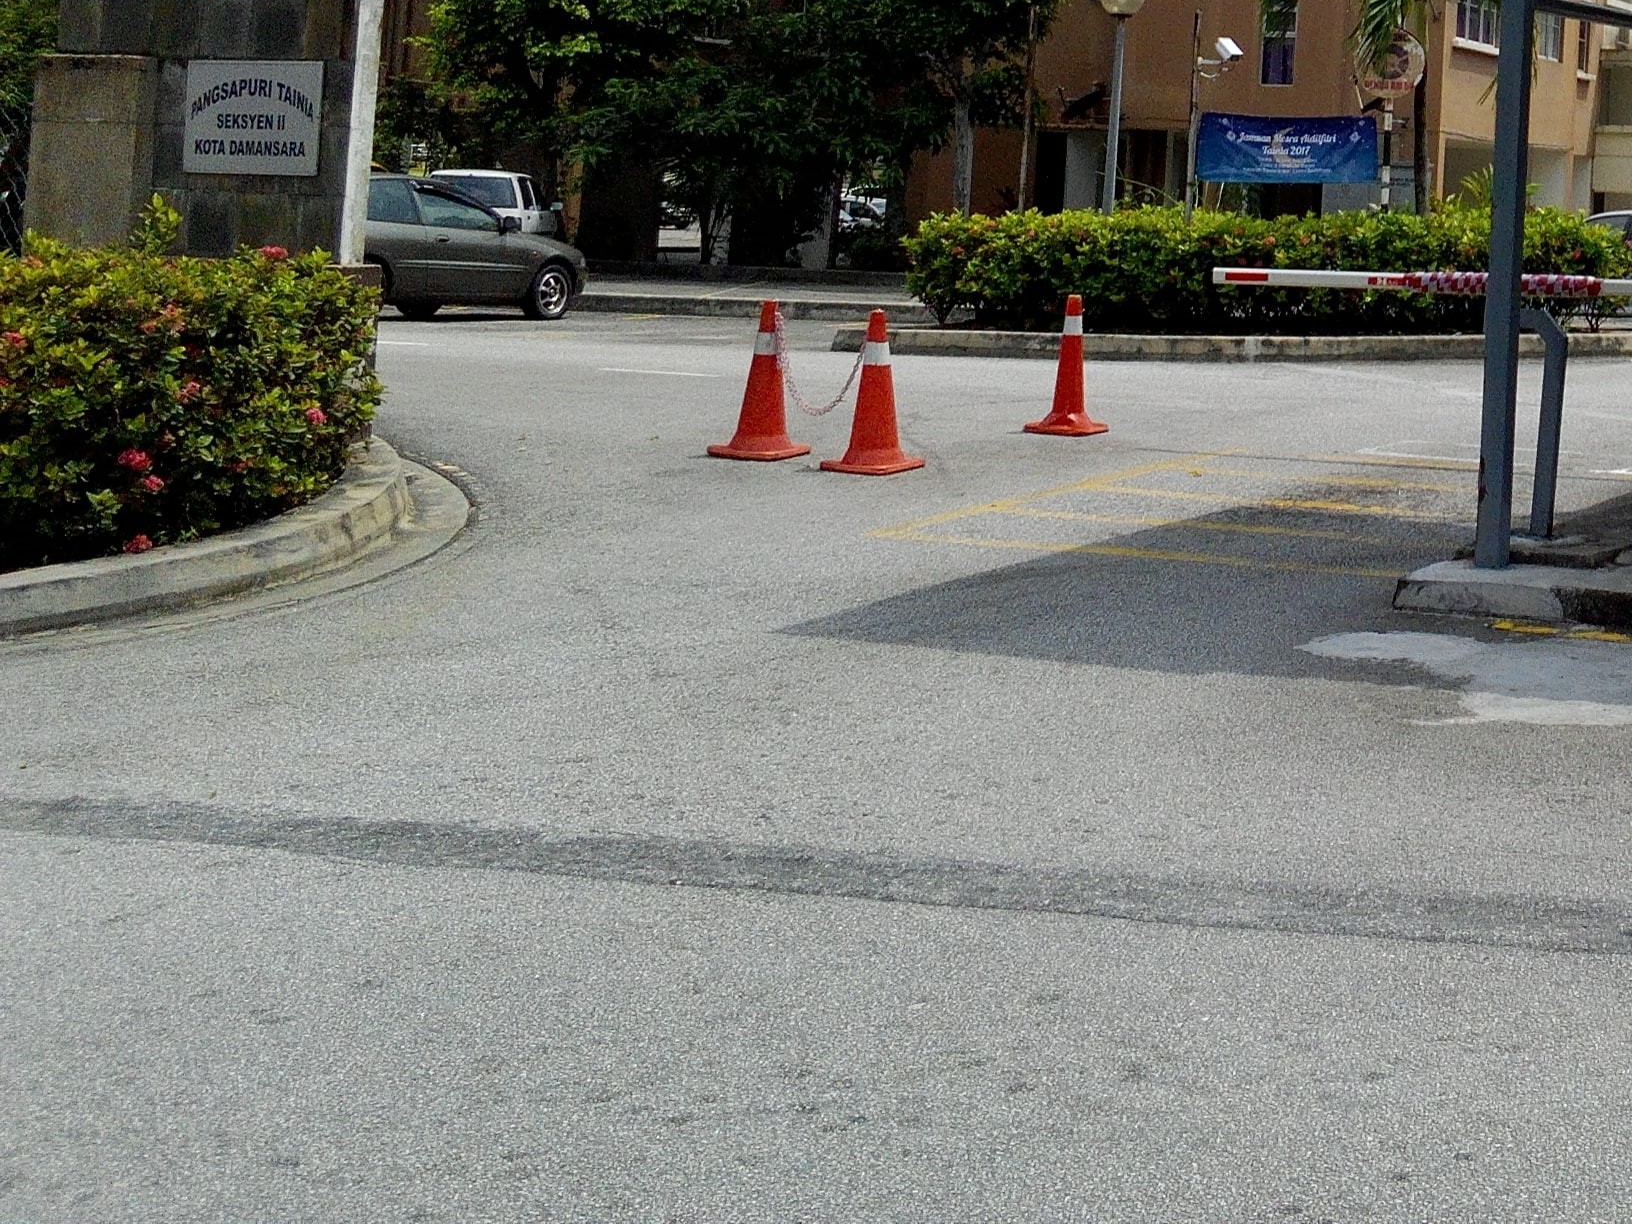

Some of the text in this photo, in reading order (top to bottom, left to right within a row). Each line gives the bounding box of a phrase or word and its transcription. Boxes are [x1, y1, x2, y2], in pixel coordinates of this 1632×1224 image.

[191, 79, 314, 122] PANGSAPURI TAINIA
[216, 114, 273, 130] SEKSYEN
[195, 139, 306, 157] KOTA DAMANSARA
[1290, 145, 1311, 156] 2017
